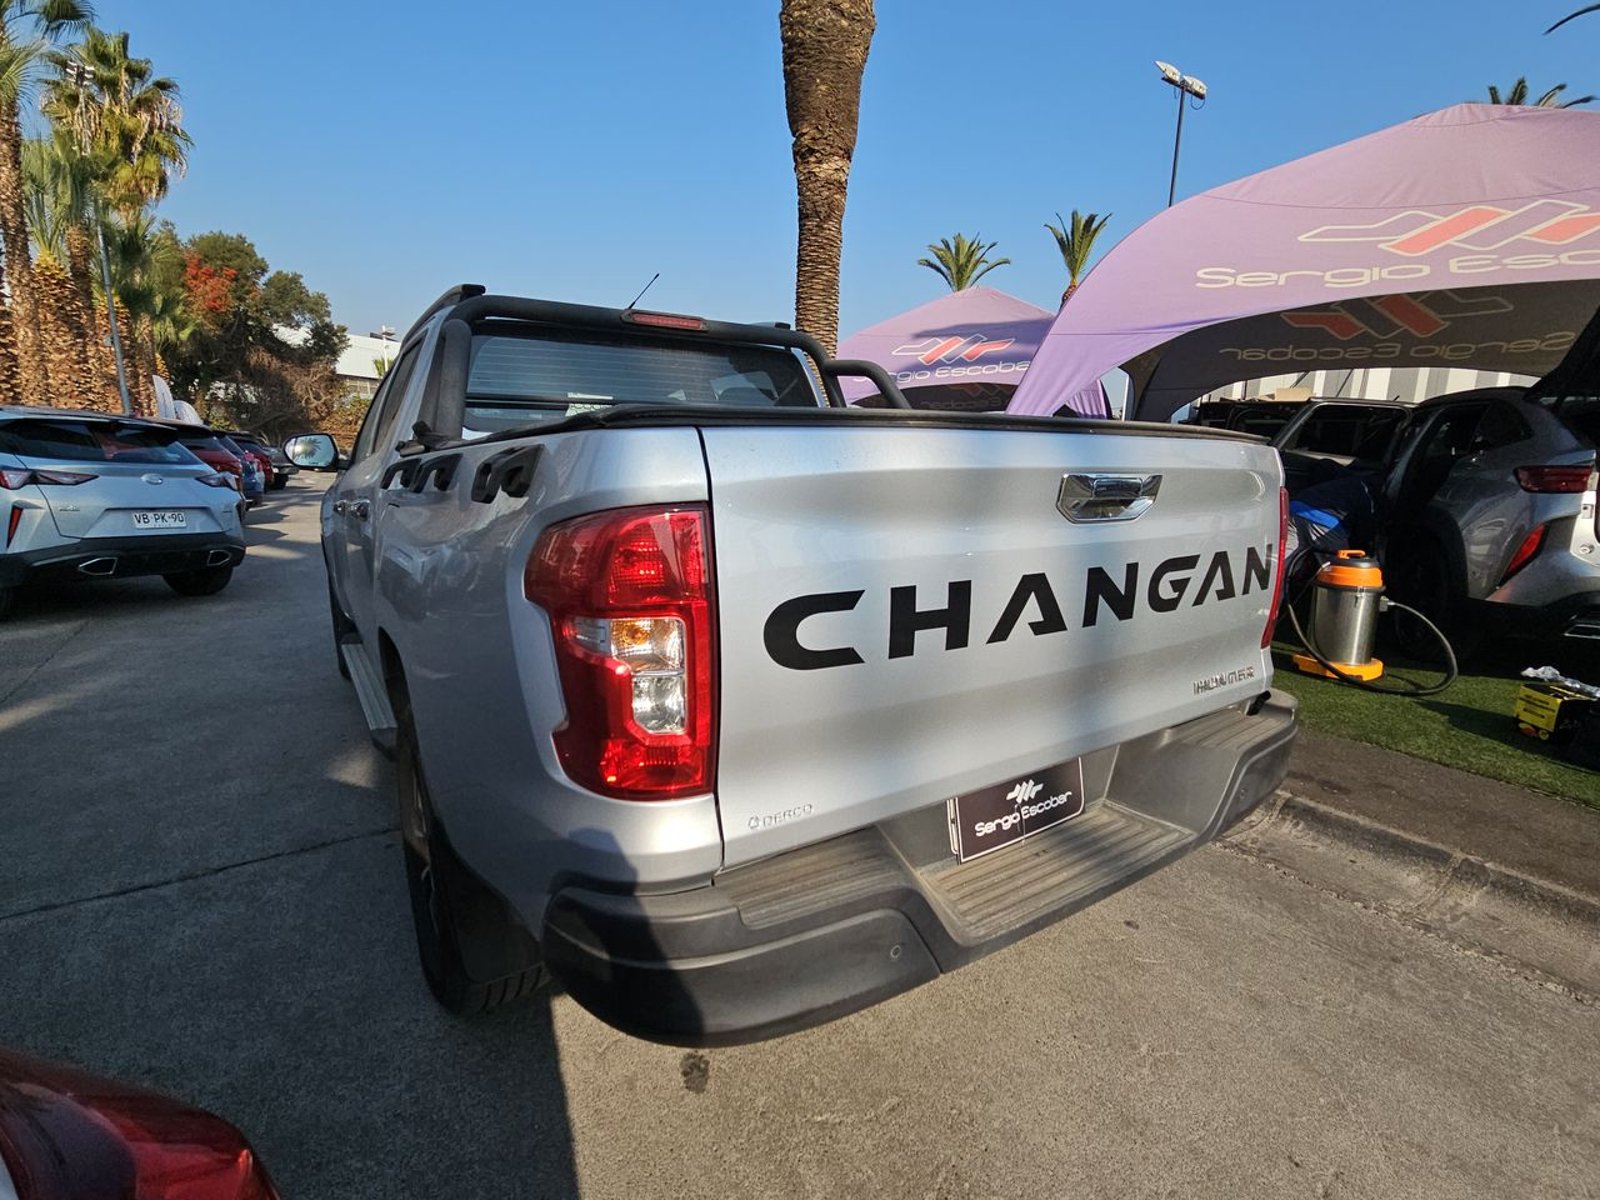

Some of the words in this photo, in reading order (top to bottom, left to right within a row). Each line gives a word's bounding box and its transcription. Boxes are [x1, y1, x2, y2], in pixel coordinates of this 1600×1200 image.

[1195, 264, 1431, 288] Sergio
[763, 543, 1273, 671] CHANGAN
[1020, 791, 1072, 820] Escobar
